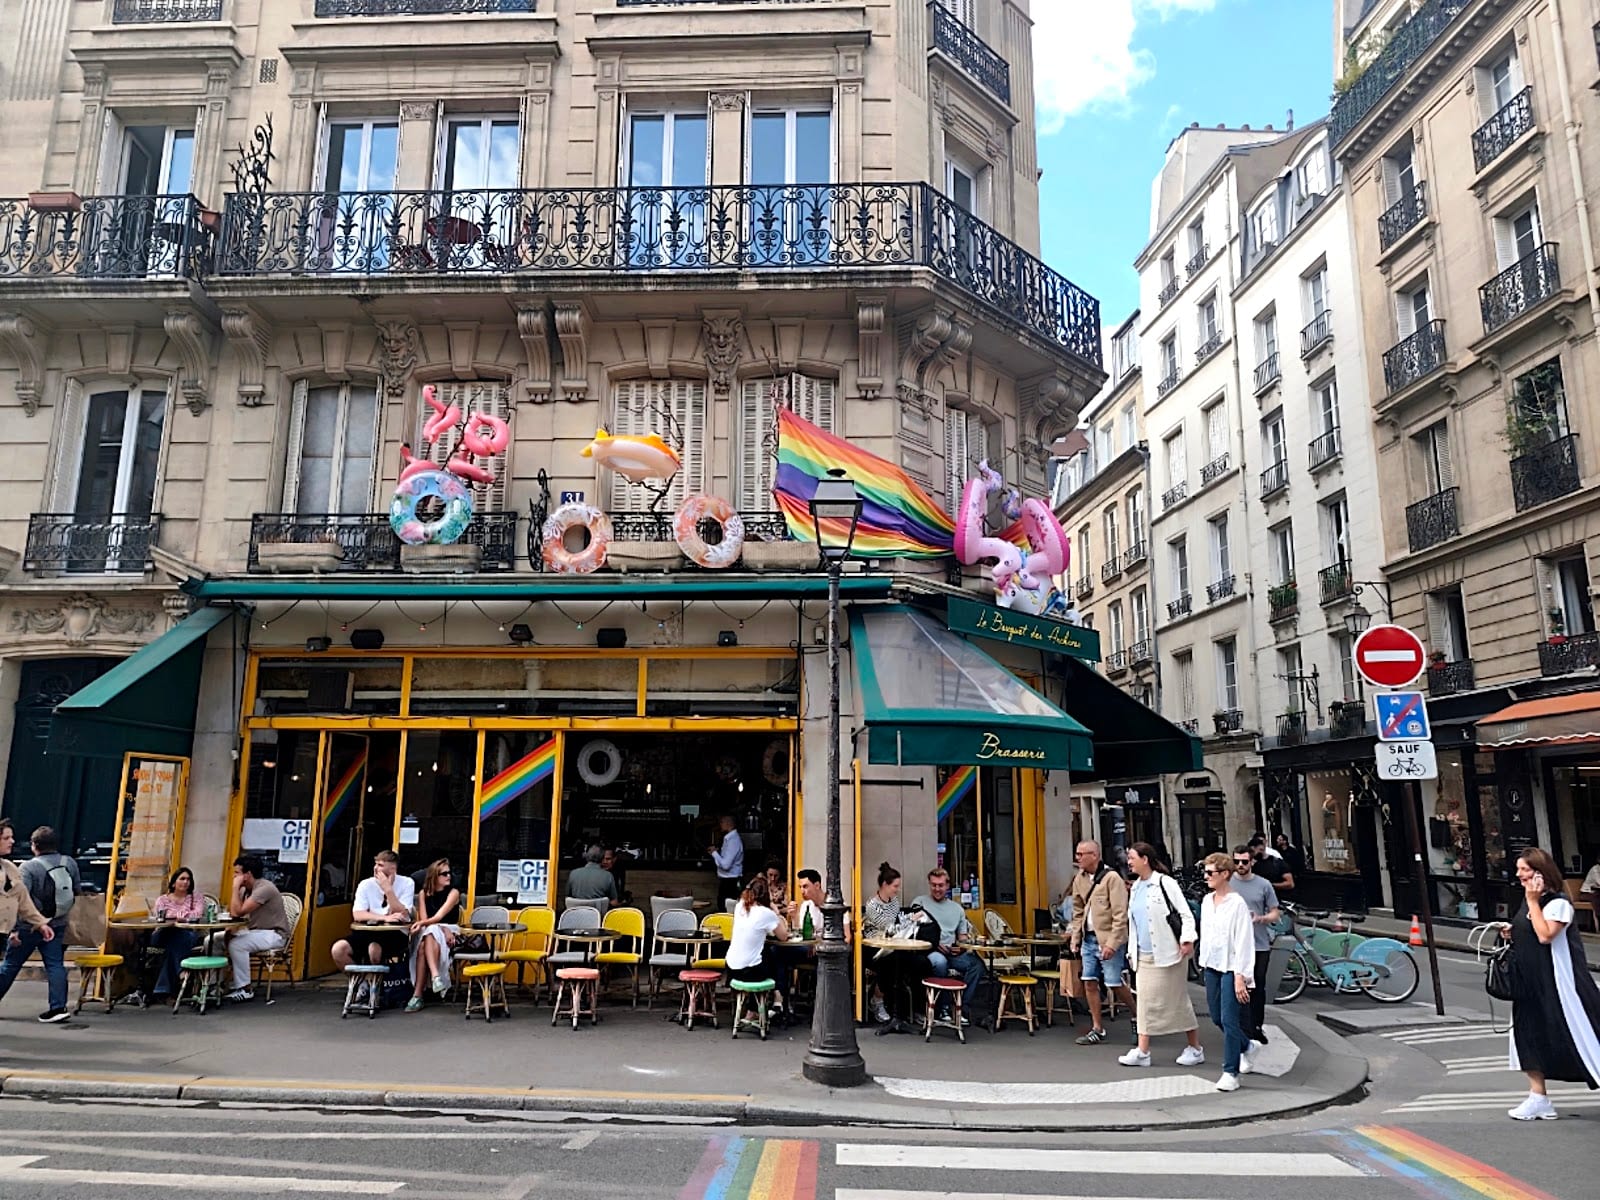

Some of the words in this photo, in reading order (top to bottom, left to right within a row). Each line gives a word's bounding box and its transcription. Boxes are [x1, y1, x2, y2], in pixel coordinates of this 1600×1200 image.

[976, 608, 987, 628] Le
[990, 611, 1028, 642] Bouquet
[975, 732, 1046, 759] Brasserie
[1388, 744, 1420, 754] SAUF
[283, 820, 310, 835] CH
[281, 835, 309, 850] UT!
[521, 861, 548, 875] CH
[520, 876, 547, 891] UT!
